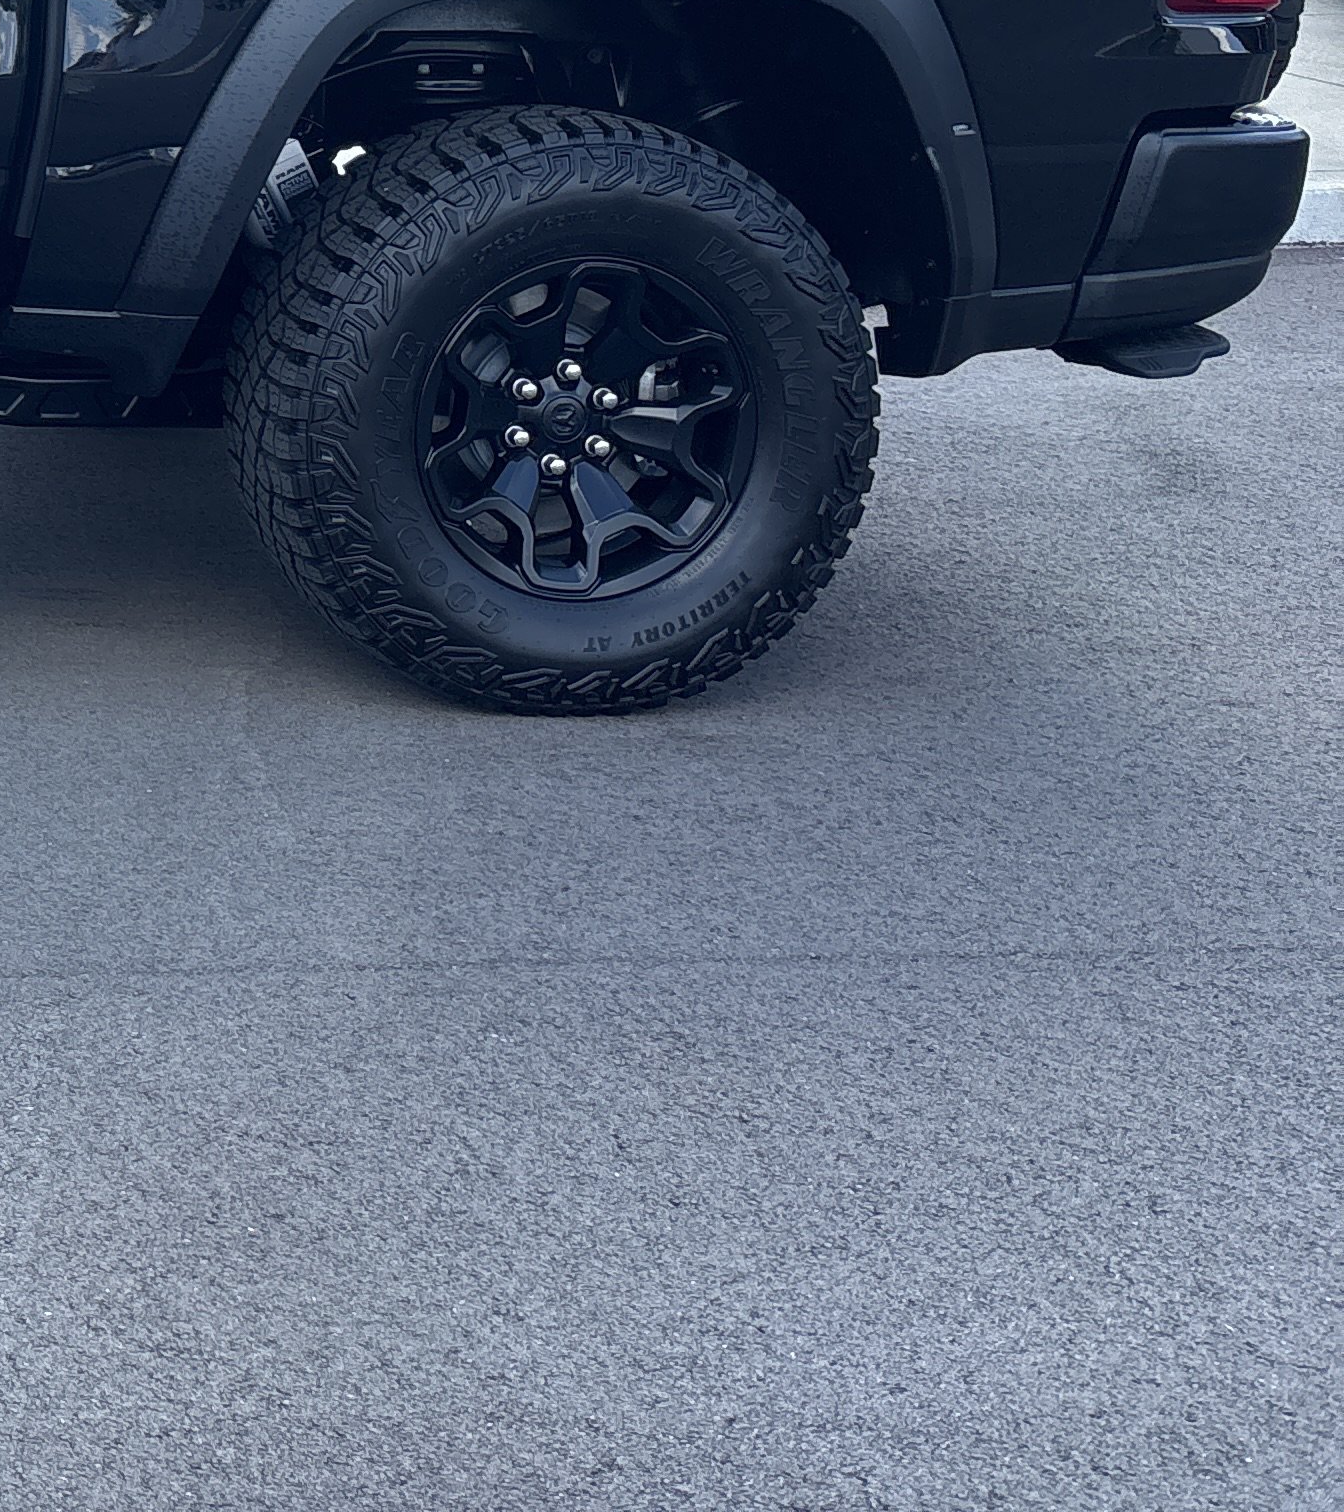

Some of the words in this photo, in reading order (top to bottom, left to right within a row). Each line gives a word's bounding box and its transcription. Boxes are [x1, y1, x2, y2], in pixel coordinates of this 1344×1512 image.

[695, 234, 818, 513] WRANGLER
[368, 329, 509, 636] GOODYEAR
[581, 635, 613, 653] AT
[630, 569, 752, 649] TERRITORY
